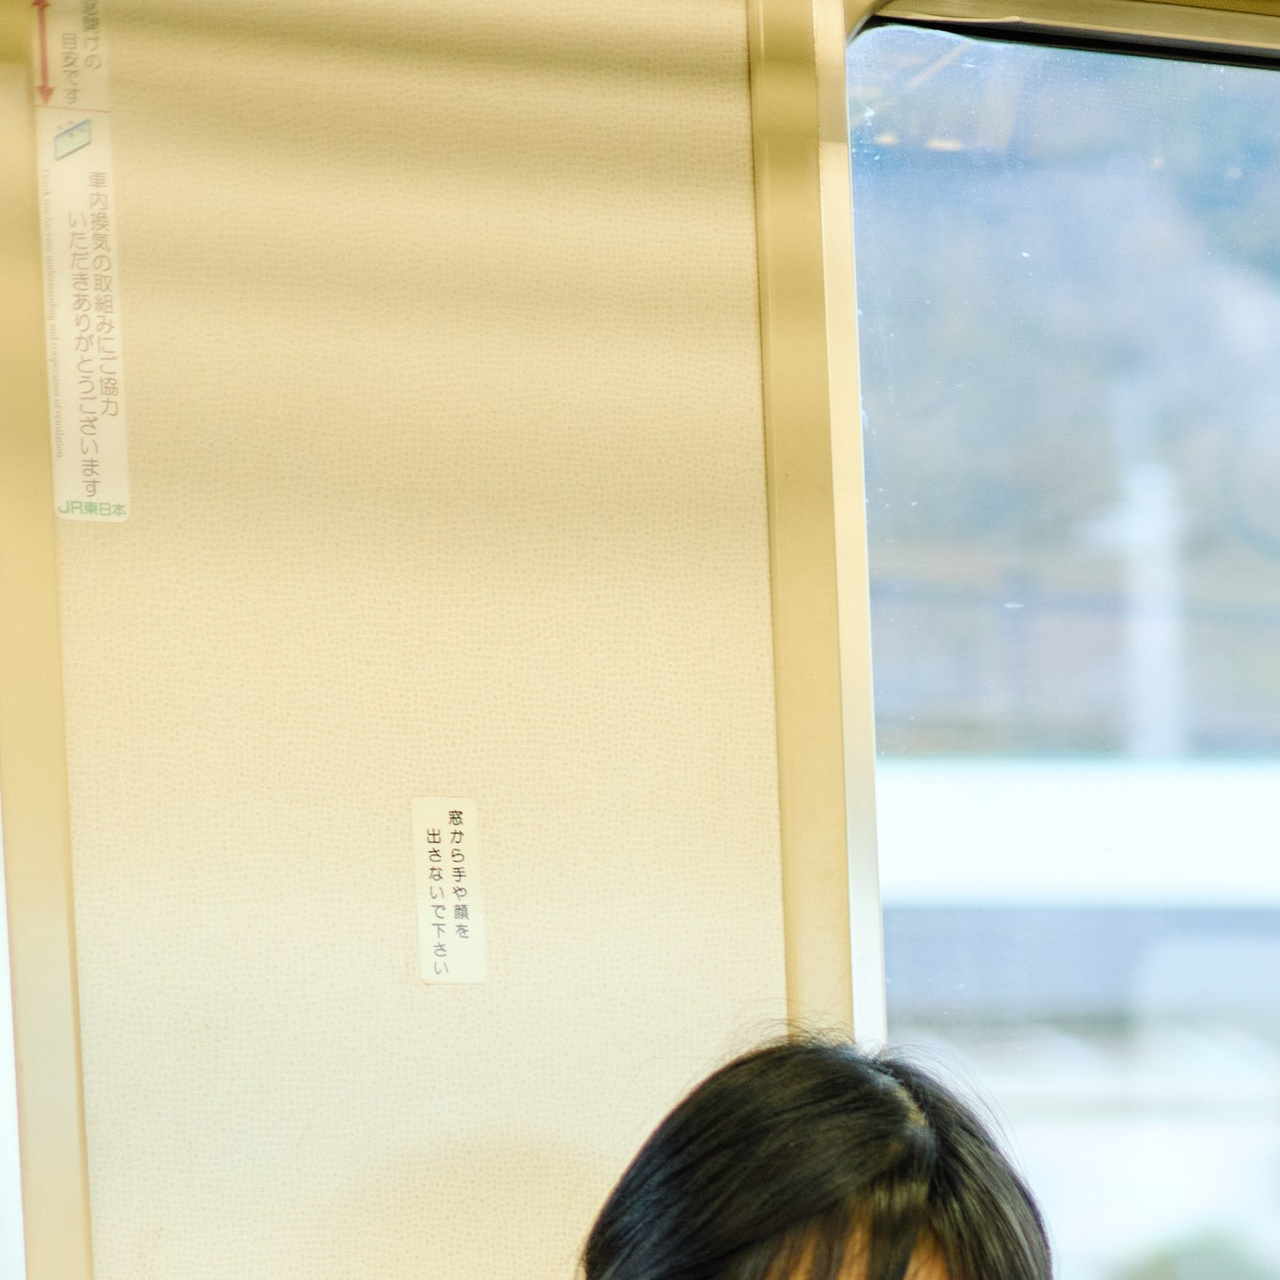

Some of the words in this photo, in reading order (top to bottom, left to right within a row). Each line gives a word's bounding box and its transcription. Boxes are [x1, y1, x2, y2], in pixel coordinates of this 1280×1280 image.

[62, 33, 80, 104] 目安です
[42, 169, 52, 197] Thank
[46, 256, 58, 321] understanding
[89, 172, 119, 416] 車内換気の取組みにご協力
[50, 343, 60, 397] cooperation
[68, 210, 101, 497] いただきありがとうございます
[58, 500, 127, 517] JR東日本
[426, 828, 449, 976] 出さないで下さい
[448, 810, 470, 939] 窓から手や顔を
